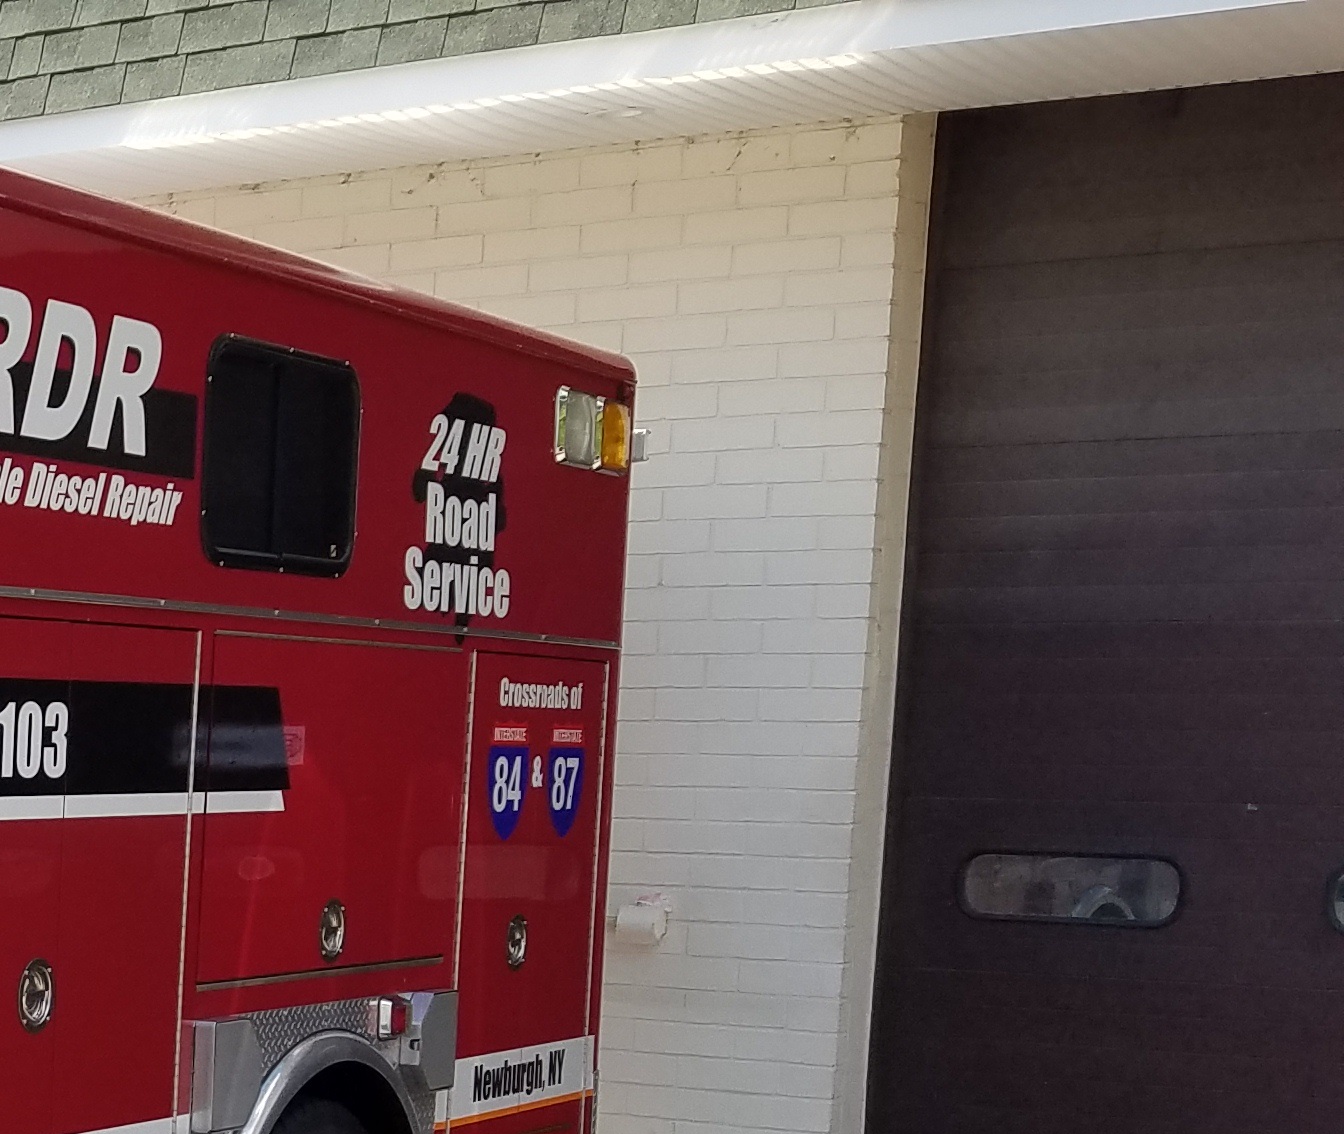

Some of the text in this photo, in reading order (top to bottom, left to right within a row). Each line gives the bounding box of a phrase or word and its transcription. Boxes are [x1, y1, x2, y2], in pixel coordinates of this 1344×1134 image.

[420, 413, 507, 483] 24 HR
[24, 462, 107, 516] Diesel
[103, 474, 183, 526] Repair
[425, 481, 497, 552] Road
[404, 545, 511, 619] Service
[499, 677, 584, 710] Crossroads of
[492, 755, 580, 813] 84 & 87
[472, 1048, 566, 1103] Newburgh, NY
